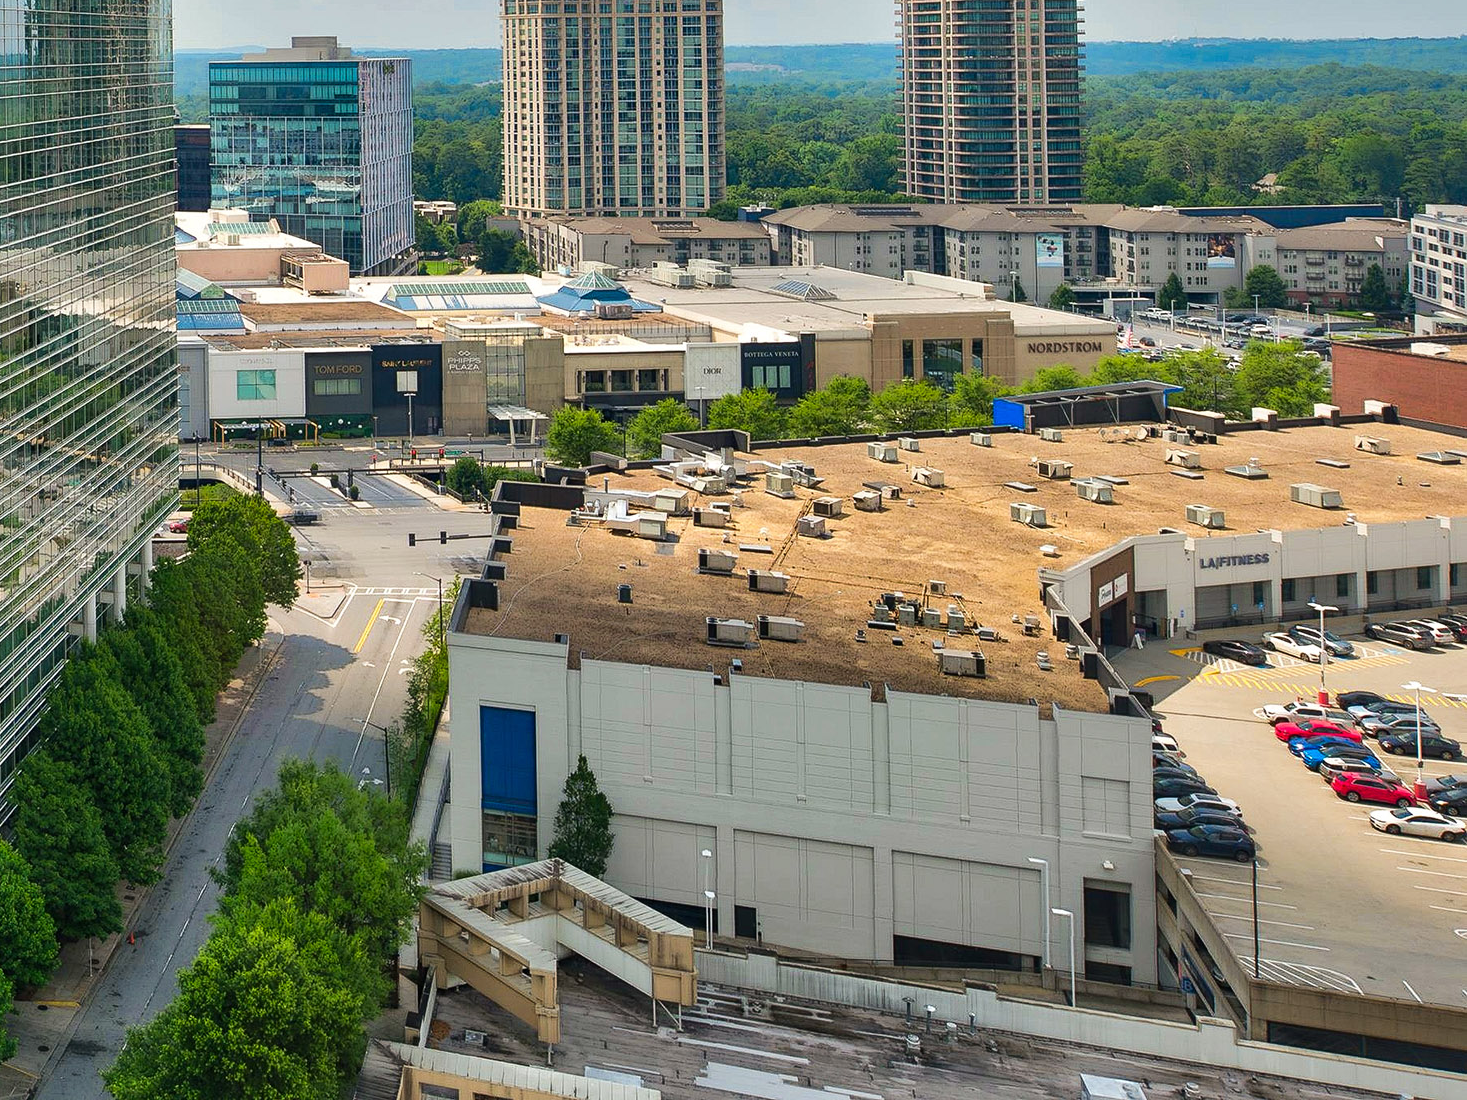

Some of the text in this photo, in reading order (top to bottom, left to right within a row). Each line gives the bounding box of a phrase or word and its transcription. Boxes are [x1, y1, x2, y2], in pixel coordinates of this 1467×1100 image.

[1028, 342, 1102, 353] NORDSTROM
[313, 364, 363, 374] TOM FORD
[703, 365, 722, 375] DIOR
